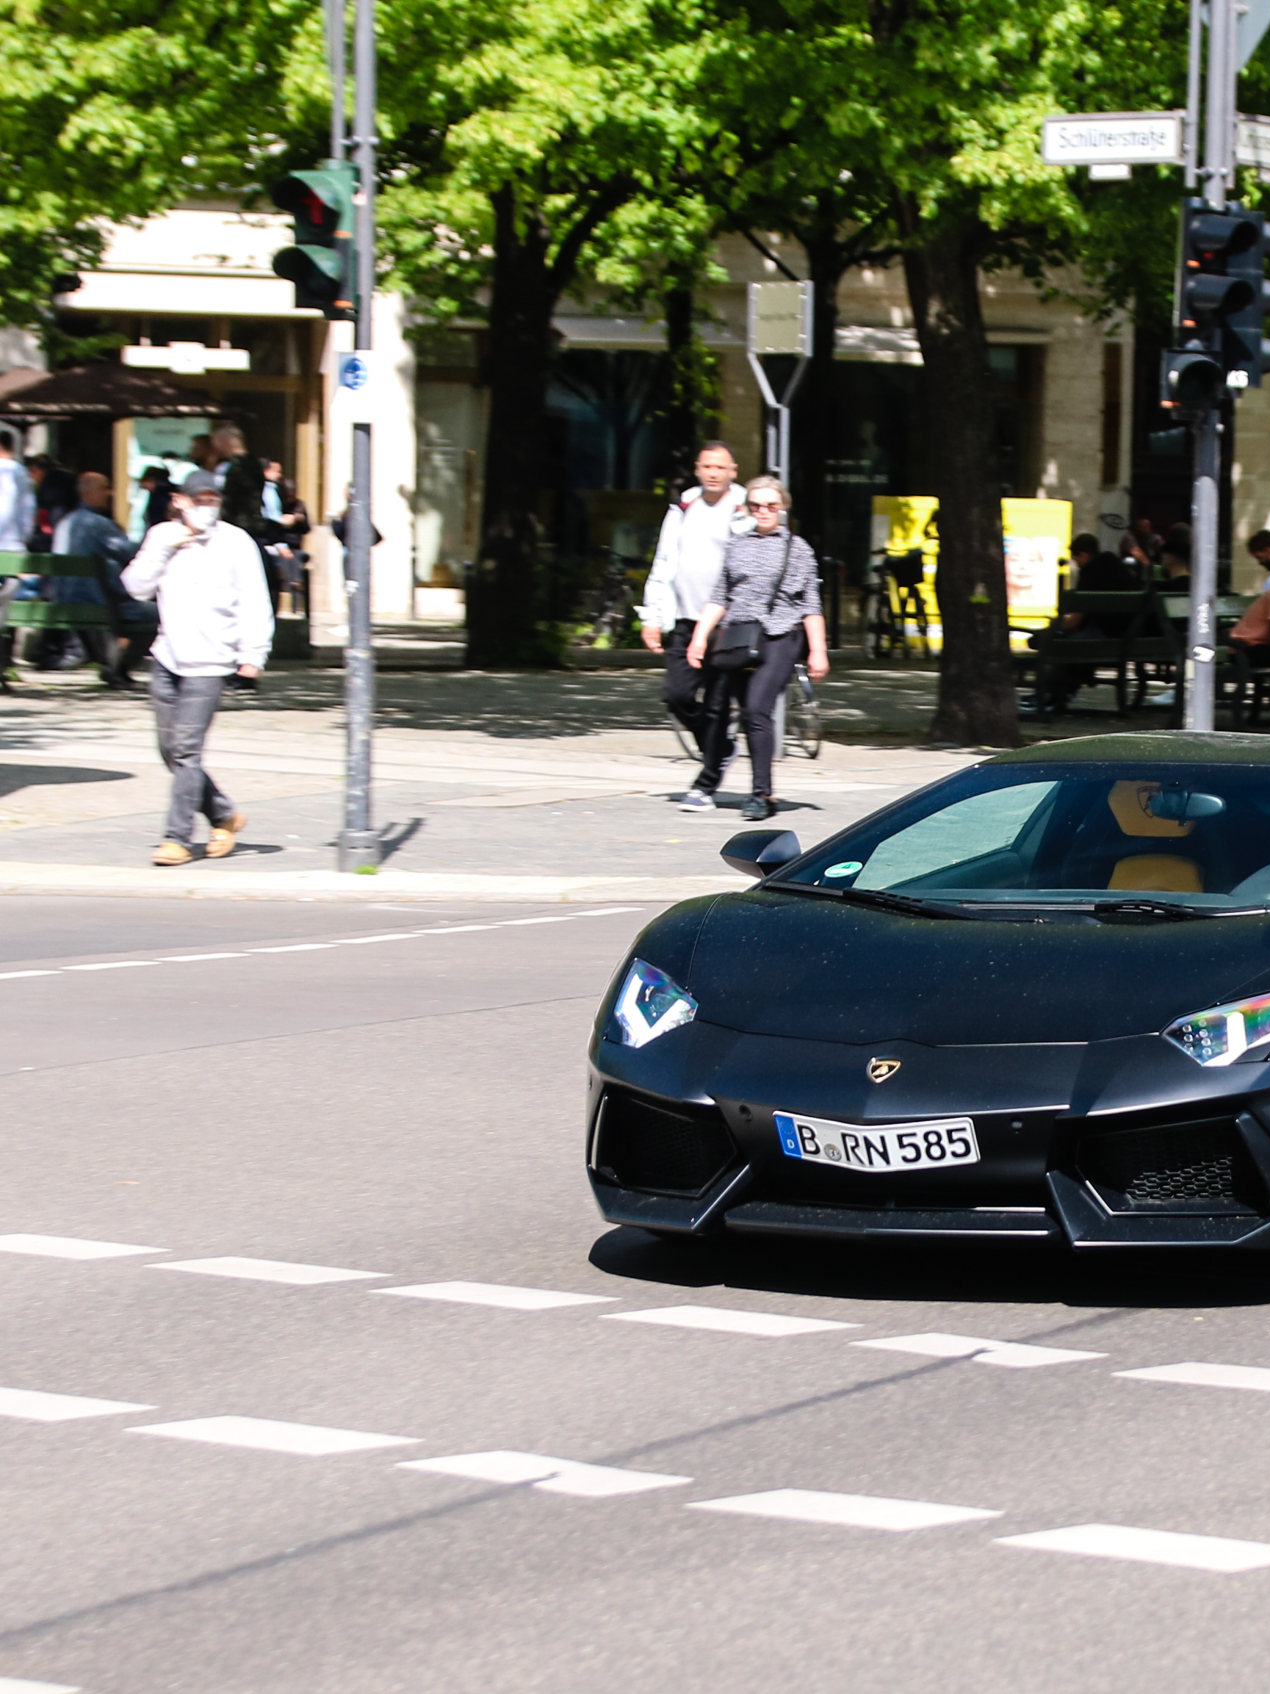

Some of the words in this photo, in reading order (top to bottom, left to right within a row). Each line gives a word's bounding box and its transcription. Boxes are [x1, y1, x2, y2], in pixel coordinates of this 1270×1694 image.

[787, 1138, 795, 1149] D
[796, 1123, 821, 1156] B
[841, 1132, 891, 1166] RN
[896, 1127, 972, 1164] 585
